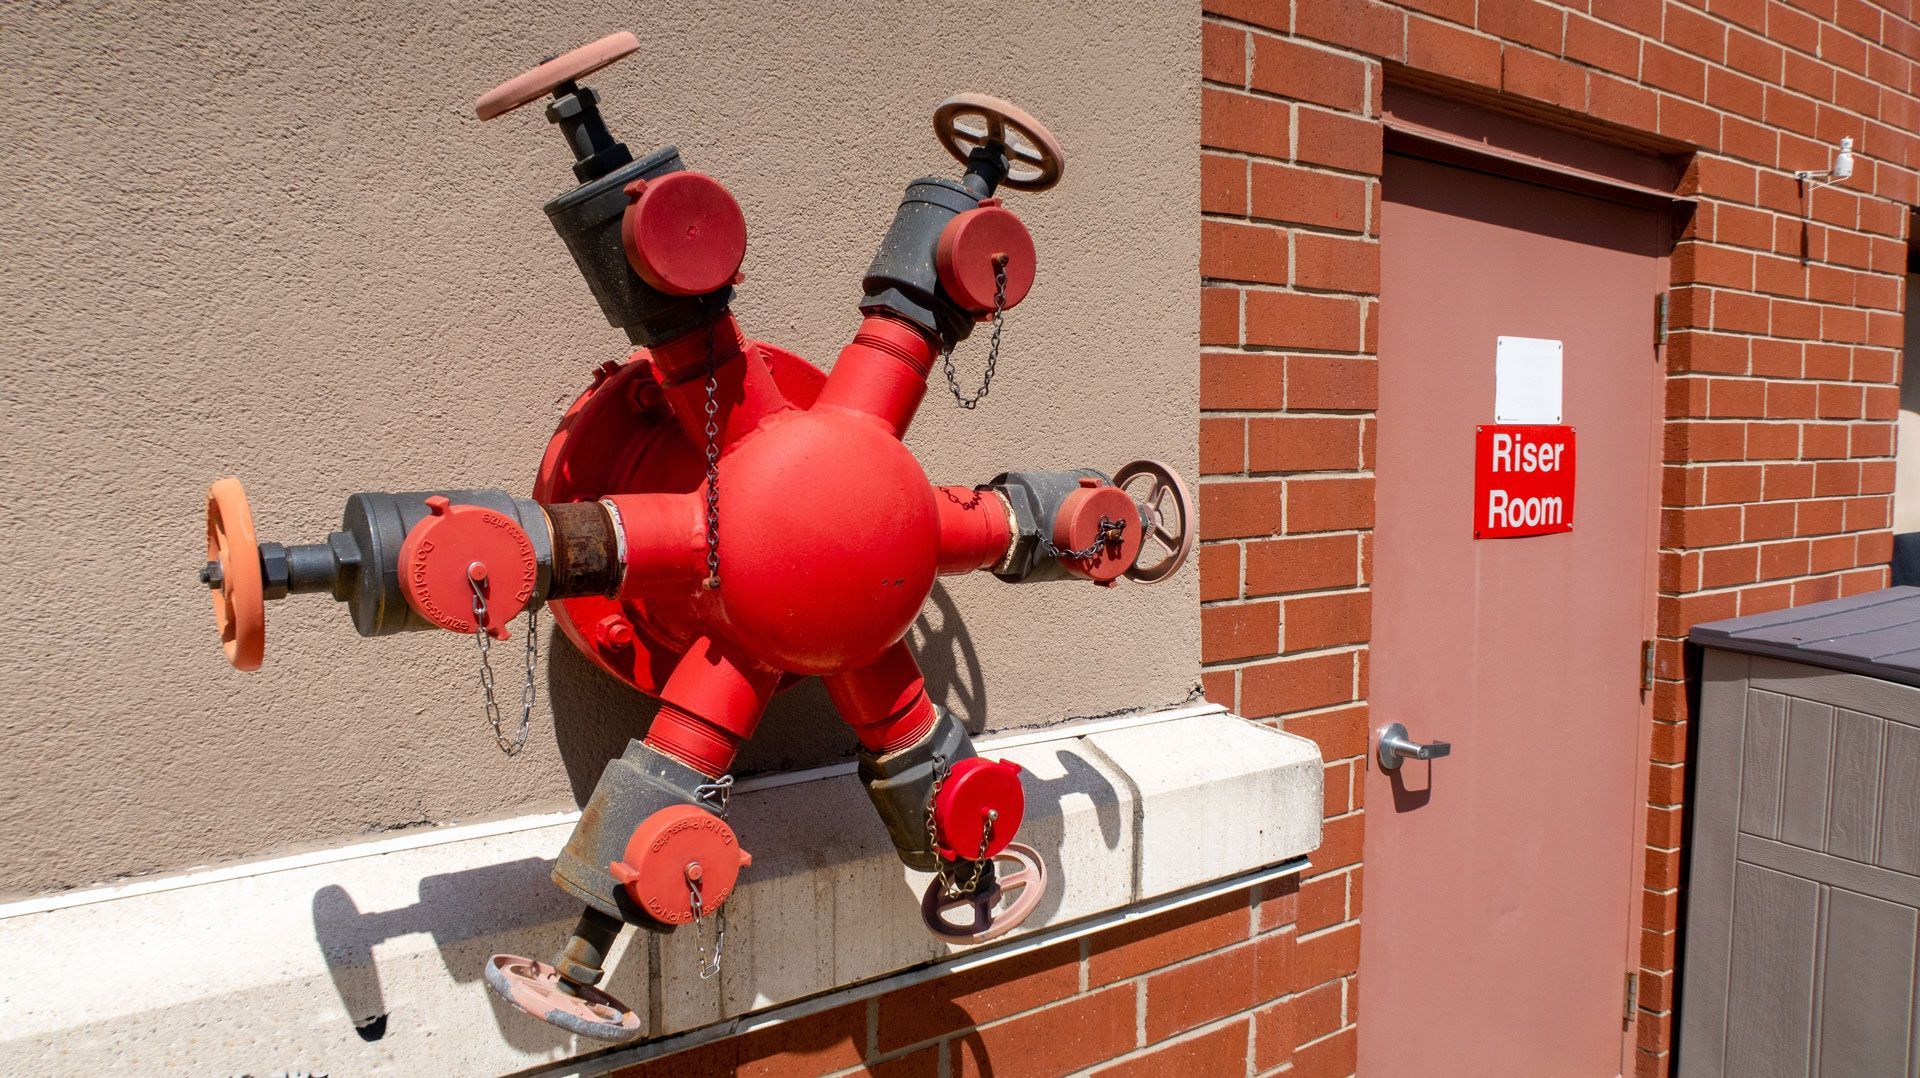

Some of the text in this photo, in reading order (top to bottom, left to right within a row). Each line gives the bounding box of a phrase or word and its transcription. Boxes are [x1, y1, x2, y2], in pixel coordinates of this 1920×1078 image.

[1492, 433, 1564, 473] Riser
[1488, 489, 1563, 529] Room
[414, 539, 470, 632] Do Not Pressurize
[523, 558, 535, 582] Not
[515, 582, 532, 604] Do
[652, 819, 734, 853] Do Not Pressurize
[647, 896, 662, 914] Do
[661, 907, 681, 922] Not
